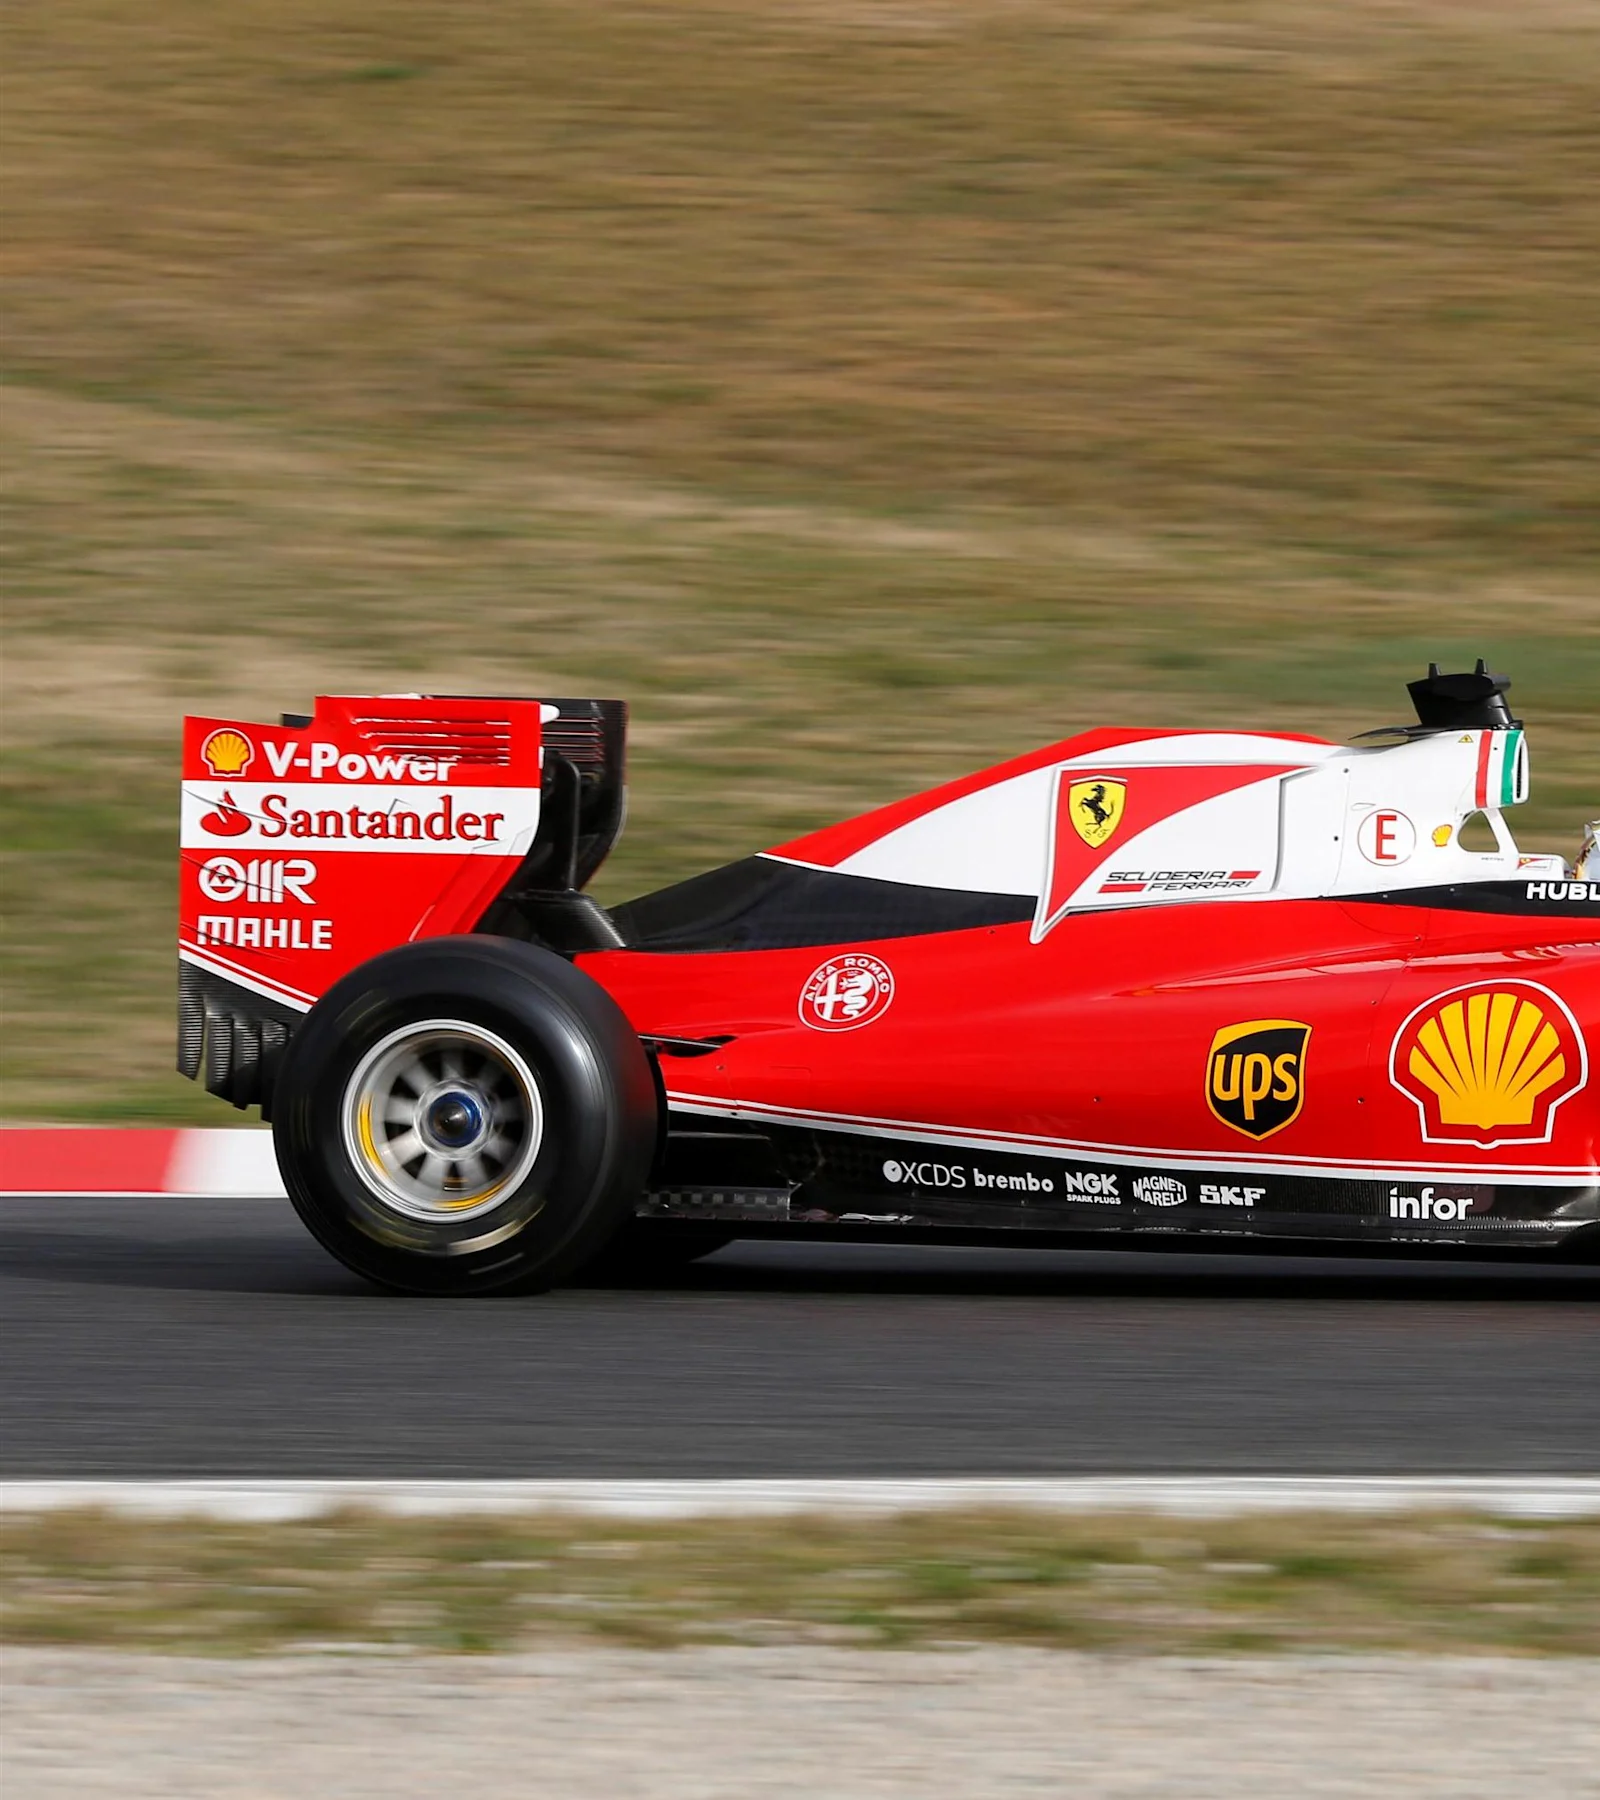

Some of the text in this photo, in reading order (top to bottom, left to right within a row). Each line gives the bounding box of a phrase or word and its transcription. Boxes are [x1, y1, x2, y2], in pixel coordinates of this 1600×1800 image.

[261, 741, 457, 781] V-Power
[258, 794, 504, 841] Santander
[1375, 814, 1398, 860] E
[198, 856, 318, 904] OMR
[1105, 871, 1227, 882] SCUDERIA
[1147, 881, 1253, 892] FERRARI
[197, 915, 333, 950] MAHLE
[805, 957, 890, 1002] ALFA ROMEO
[1212, 1053, 1298, 1121] ups
[973, 1168, 1054, 1193] brembo
[1065, 1171, 1119, 1196] NGK
[1199, 1184, 1266, 1207] SKF
[1066, 1193, 1121, 1205] SPARK PLUGS
[1389, 1187, 1474, 1221] infor
